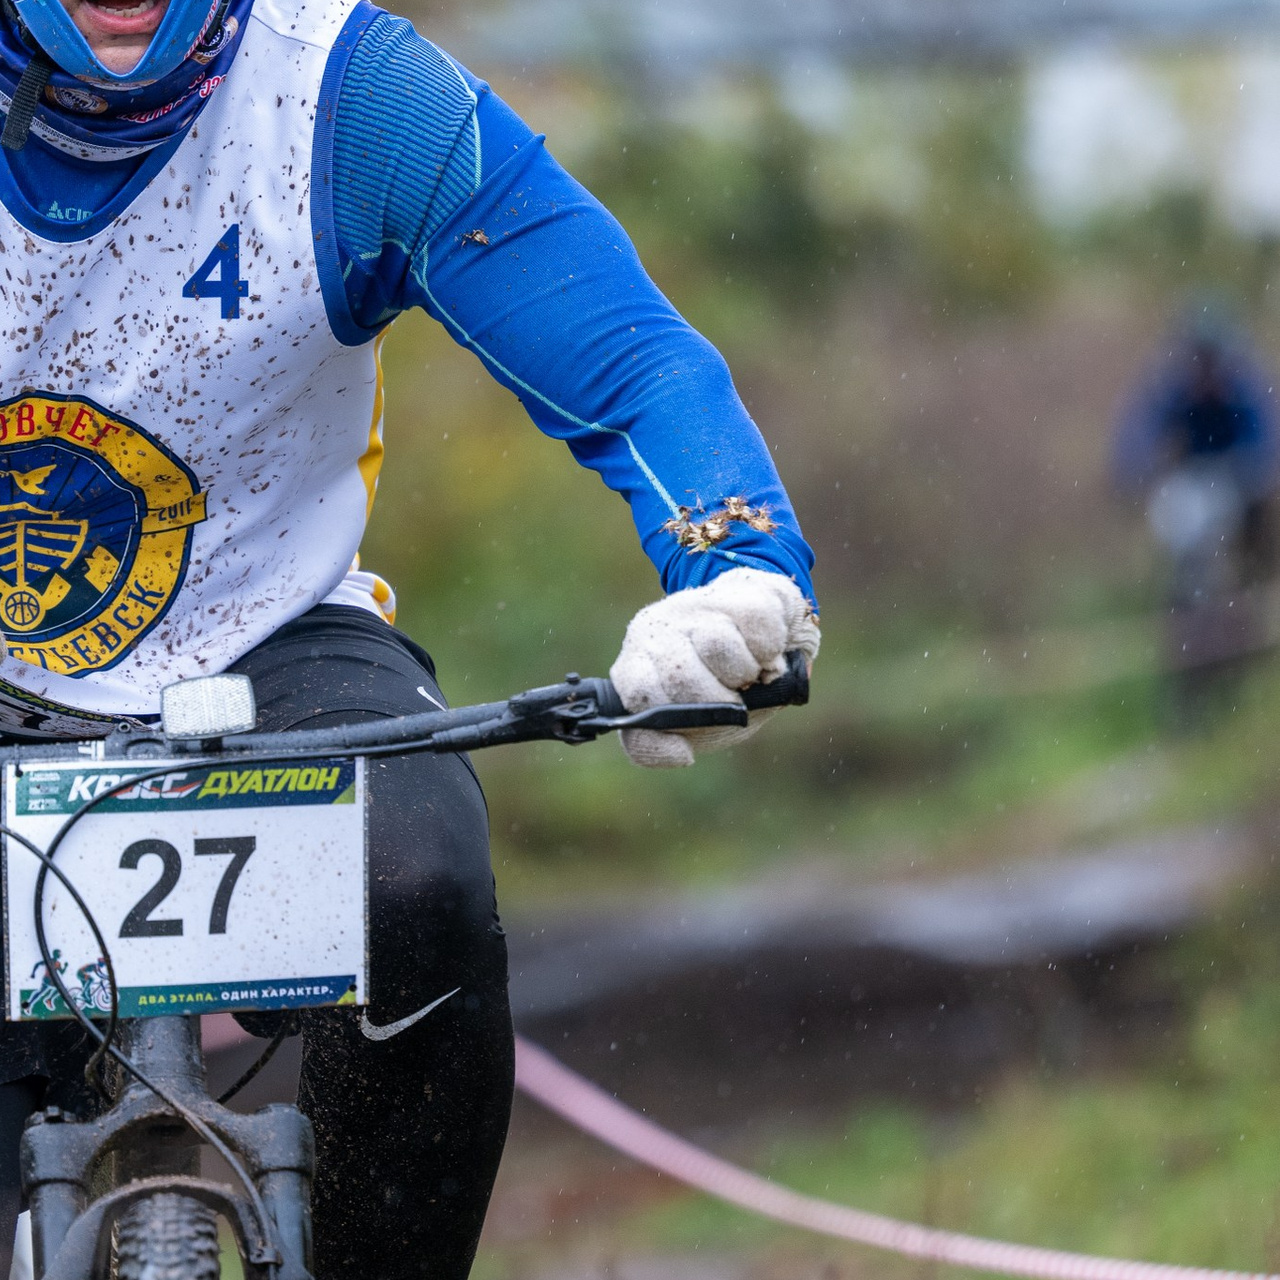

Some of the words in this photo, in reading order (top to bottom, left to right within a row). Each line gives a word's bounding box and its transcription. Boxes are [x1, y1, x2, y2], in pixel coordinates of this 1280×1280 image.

[182, 223, 249, 319] 4
[196, 767, 340, 800] ДУАТЛОН
[118, 836, 257, 938] 27
[138, 995, 166, 1006] ДВА
[170, 992, 218, 1003] ЭТАПА.
[221, 989, 259, 1001] ОДИН
[261, 985, 334, 999] ХАРАКТЕР.
